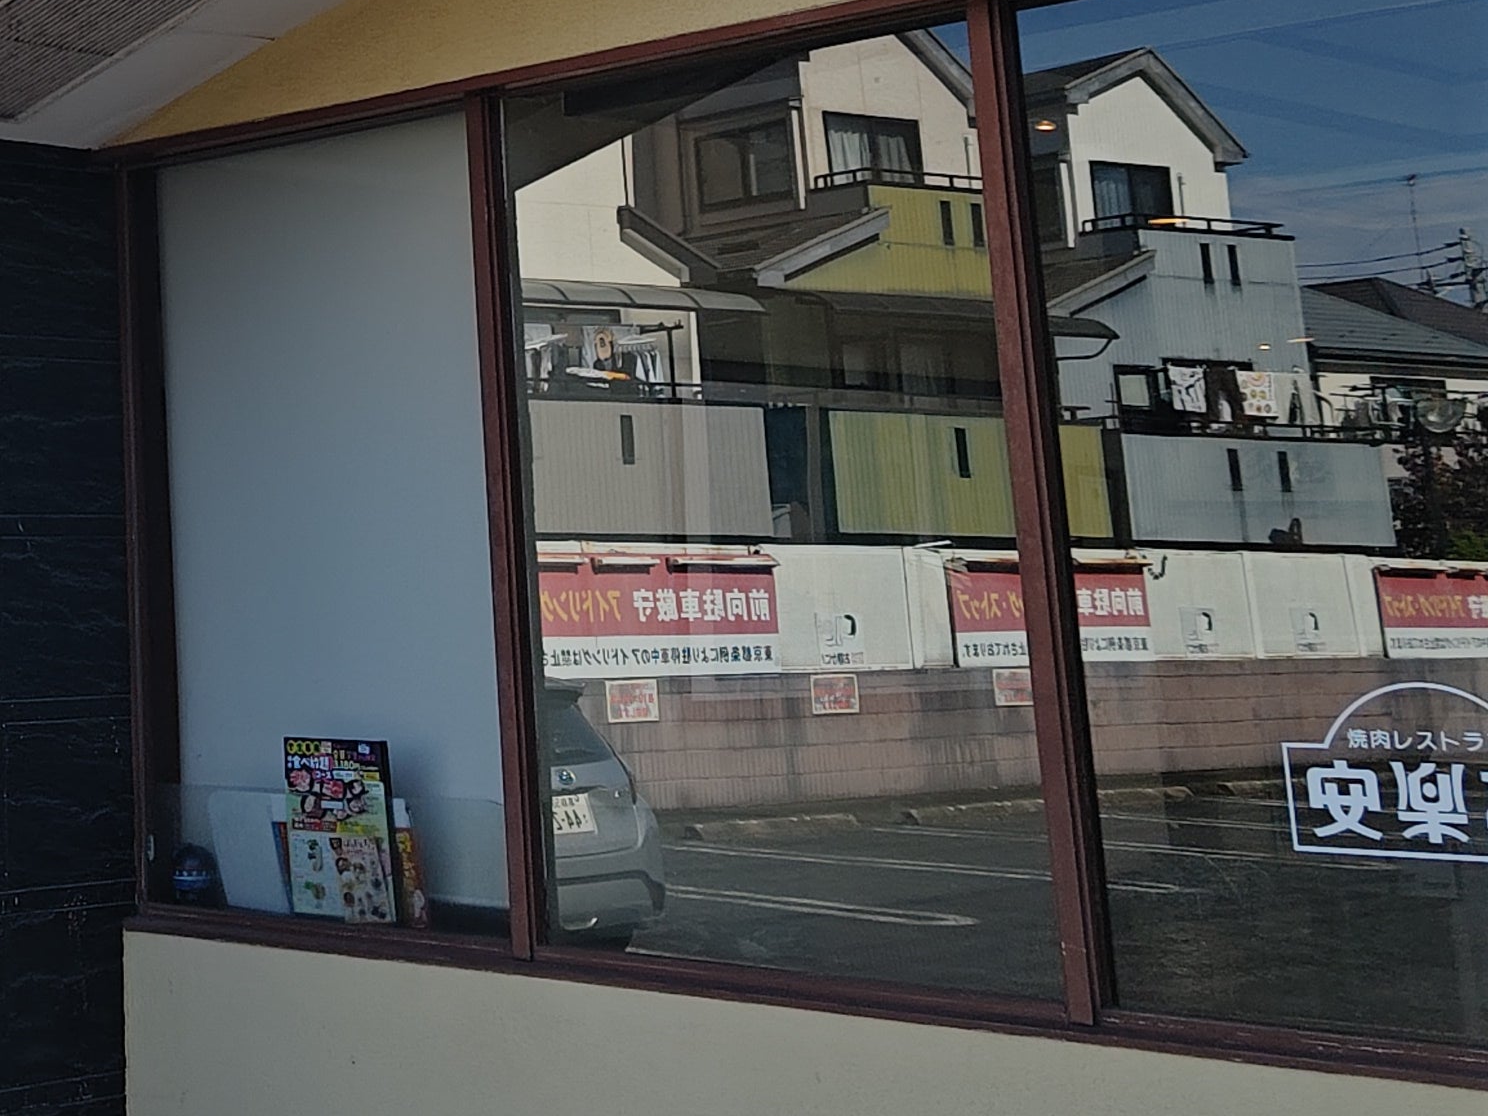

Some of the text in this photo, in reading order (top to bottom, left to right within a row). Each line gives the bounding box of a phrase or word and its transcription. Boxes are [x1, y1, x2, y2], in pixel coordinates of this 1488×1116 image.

[1346, 728, 1488, 752] 焼肉レストラ
[1306, 759, 1488, 844] 安楽
